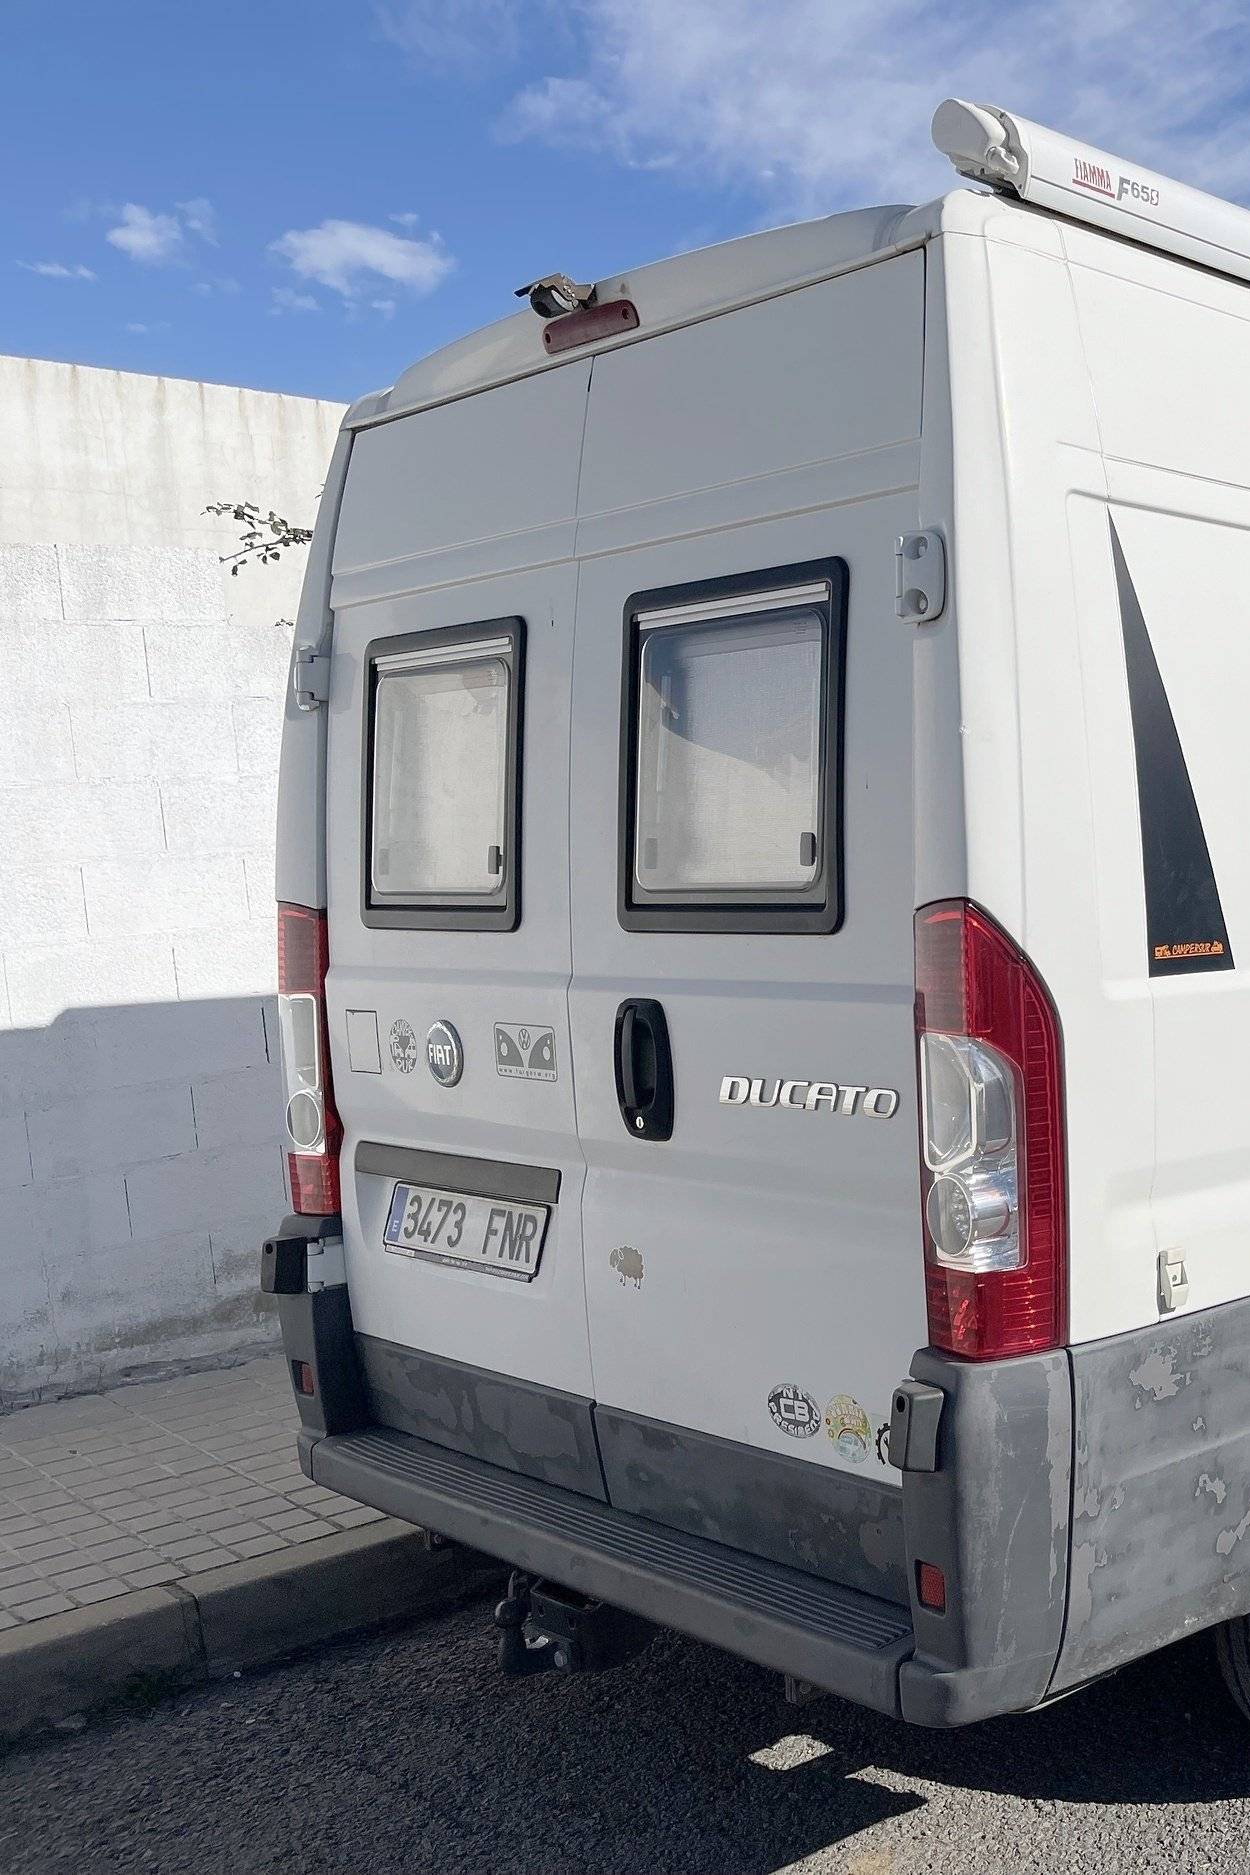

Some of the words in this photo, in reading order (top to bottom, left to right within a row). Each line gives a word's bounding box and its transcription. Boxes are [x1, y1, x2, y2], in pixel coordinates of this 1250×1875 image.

[428, 1043, 452, 1066] FIAT
[719, 1075, 899, 1119] DUCATO
[392, 1220, 399, 1232] E
[403, 1194, 467, 1248] 3473
[481, 1207, 538, 1264] FNR
[779, 1397, 810, 1422] CB
